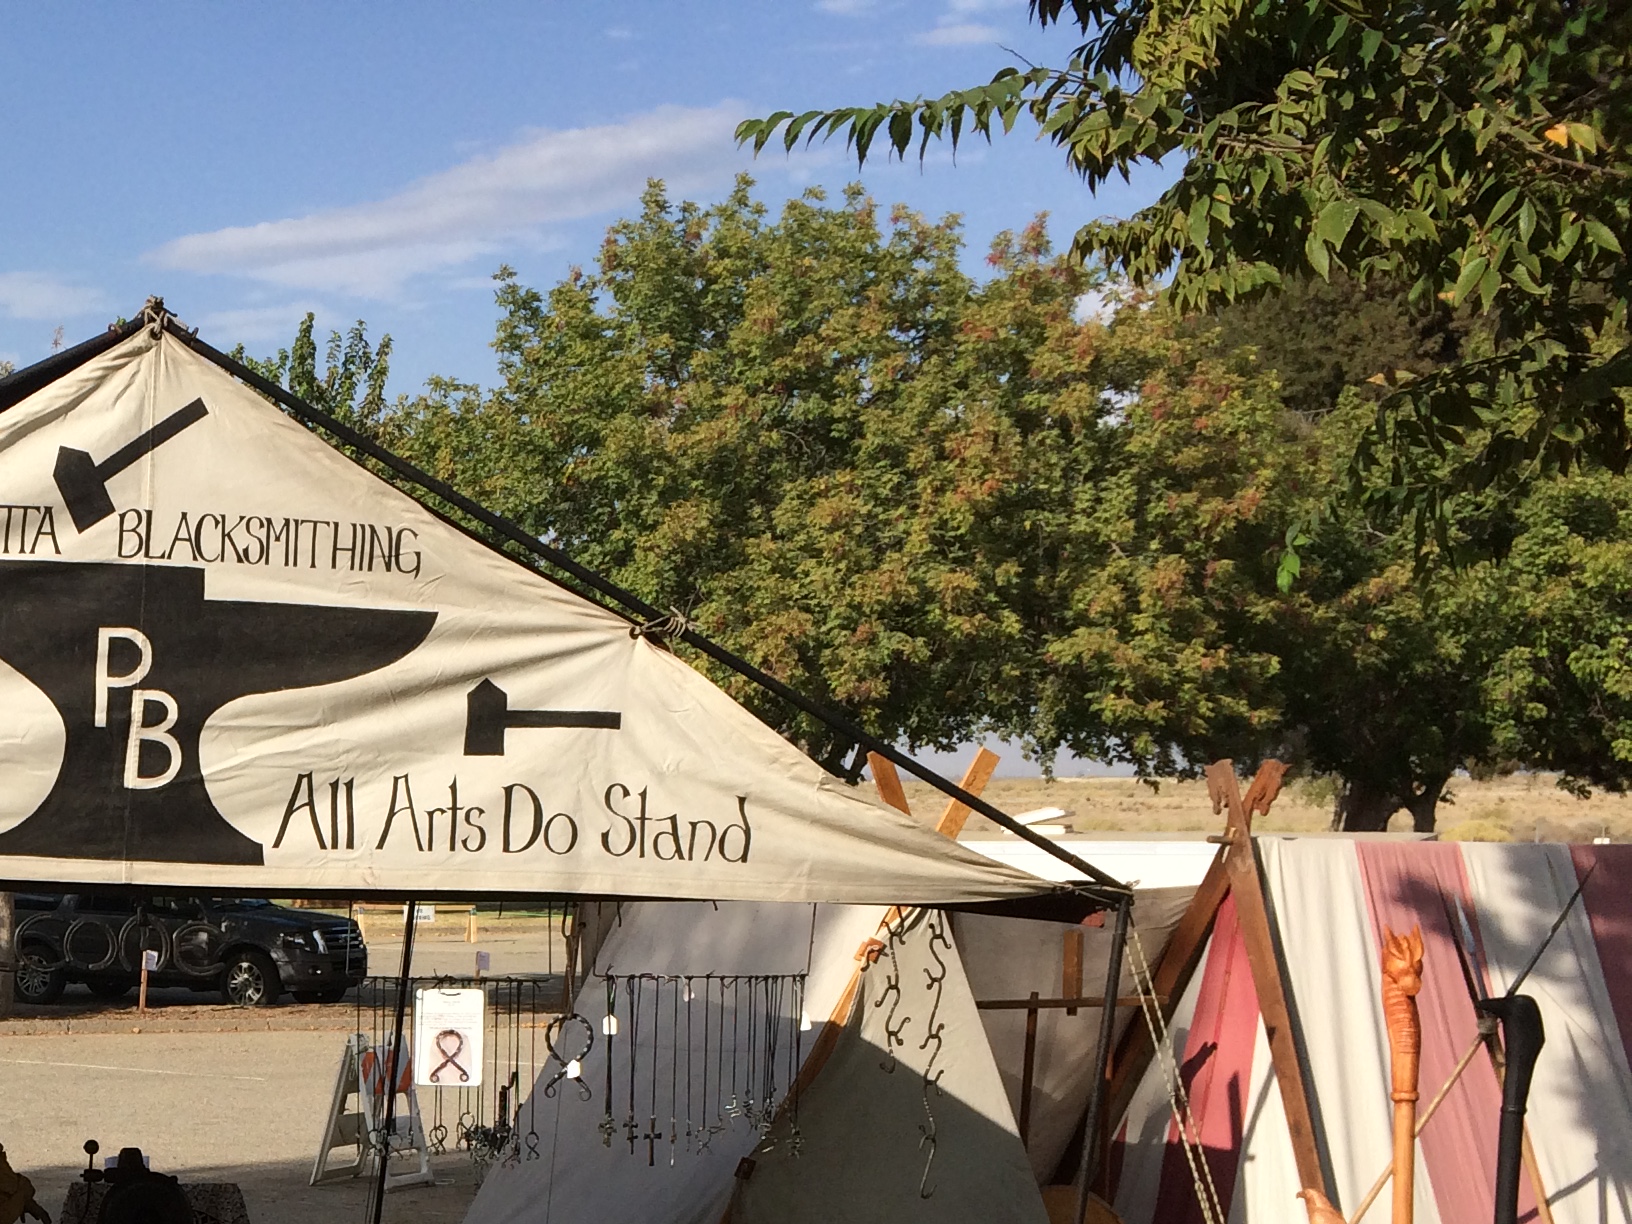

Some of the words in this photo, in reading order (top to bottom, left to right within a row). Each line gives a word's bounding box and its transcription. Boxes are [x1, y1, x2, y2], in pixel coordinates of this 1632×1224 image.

[117, 509, 422, 578] BLACKSMITHING
[272, 770, 355, 850] All
[375, 773, 487, 853] Arts
[501, 783, 579, 855] Do
[600, 782, 752, 864] Stand
